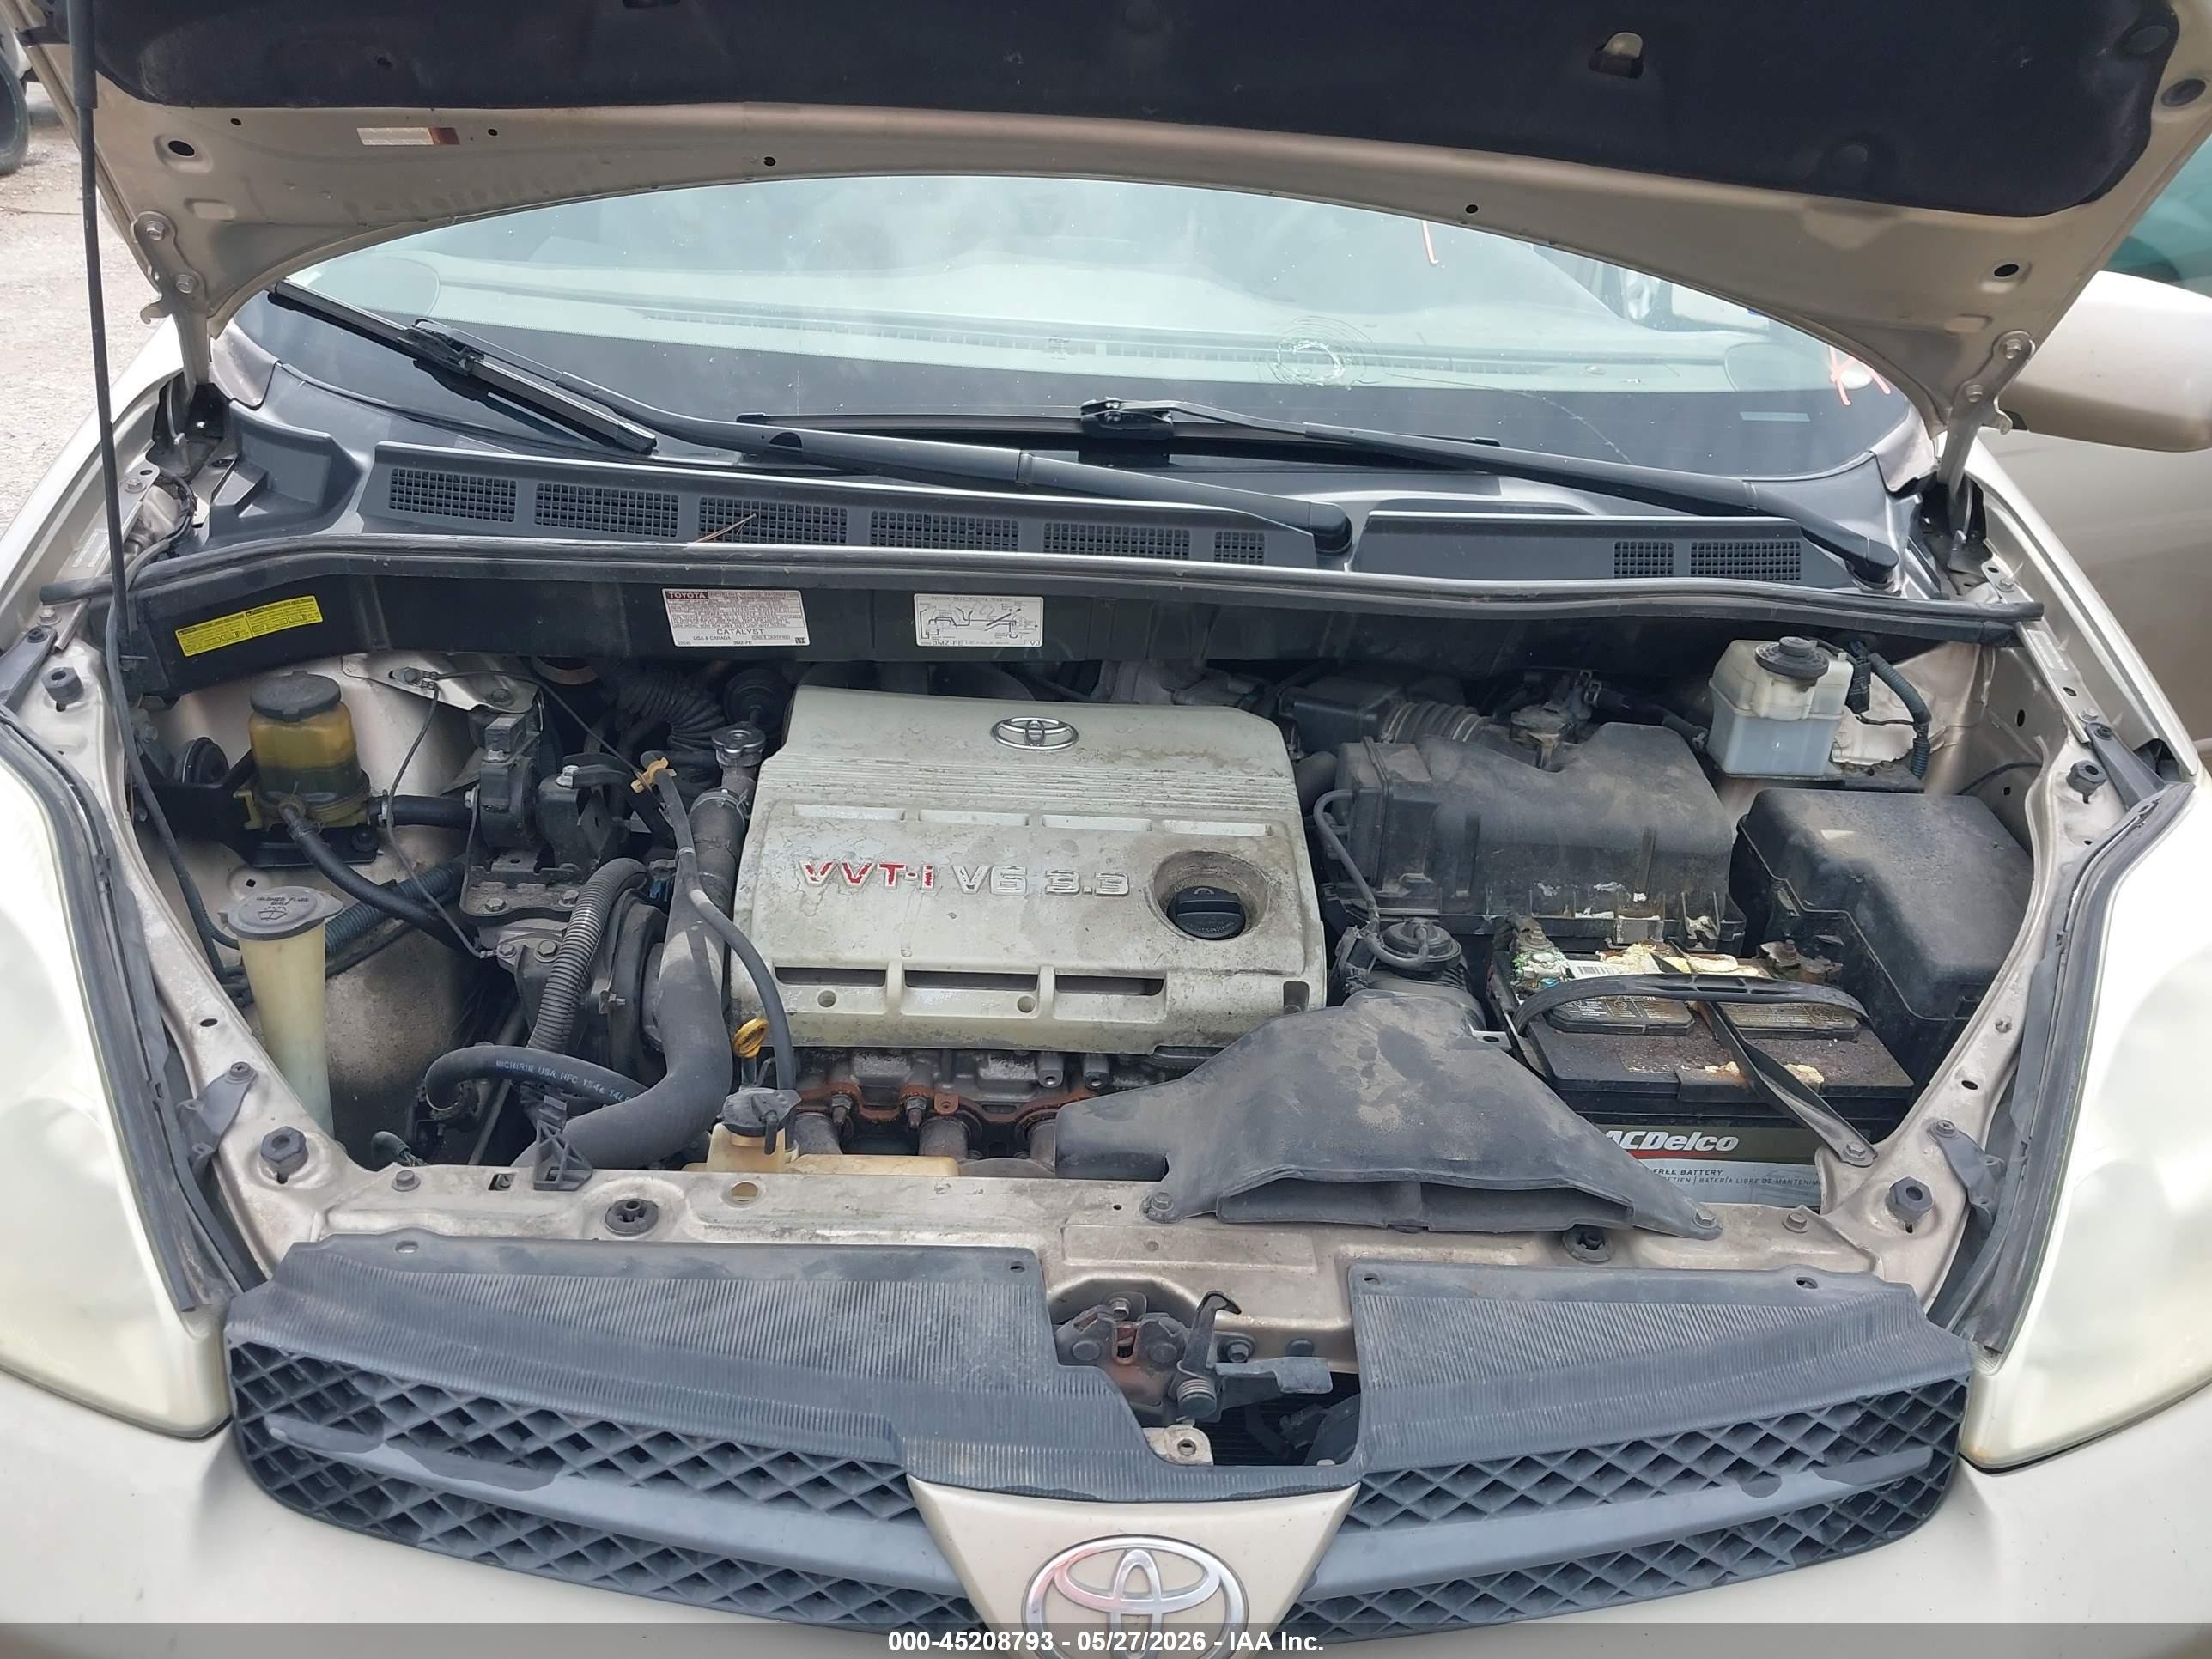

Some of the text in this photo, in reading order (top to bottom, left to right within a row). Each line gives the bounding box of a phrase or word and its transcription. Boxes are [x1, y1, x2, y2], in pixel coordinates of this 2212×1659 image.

[951, 864, 1028, 895] V6
[1044, 870, 1130, 896] 3.3
[538, 1066, 556, 1079] USA
[1606, 1130, 1740, 1152] ACDelco
